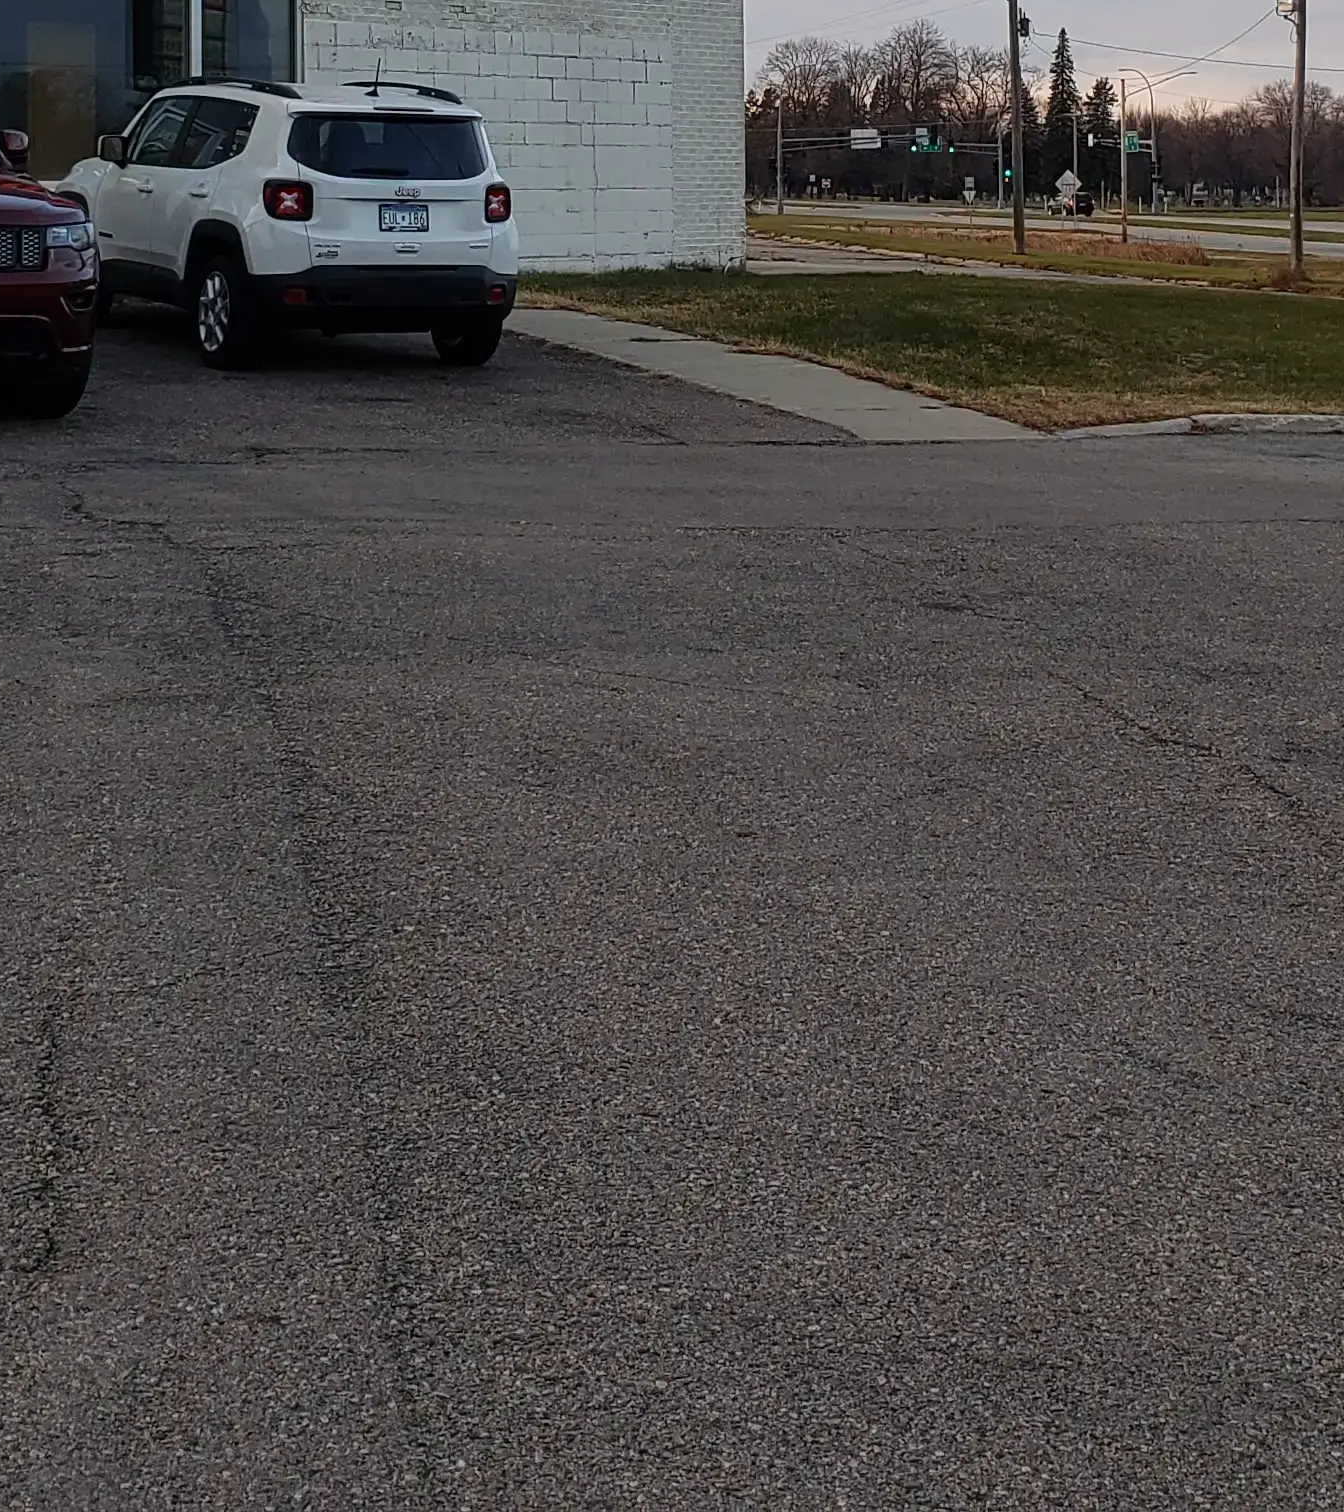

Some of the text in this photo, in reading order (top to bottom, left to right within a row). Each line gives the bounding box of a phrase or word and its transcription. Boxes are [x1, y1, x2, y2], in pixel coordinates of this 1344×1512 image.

[394, 186, 421, 198] Jeep
[383, 212, 425, 225] EUL 186
